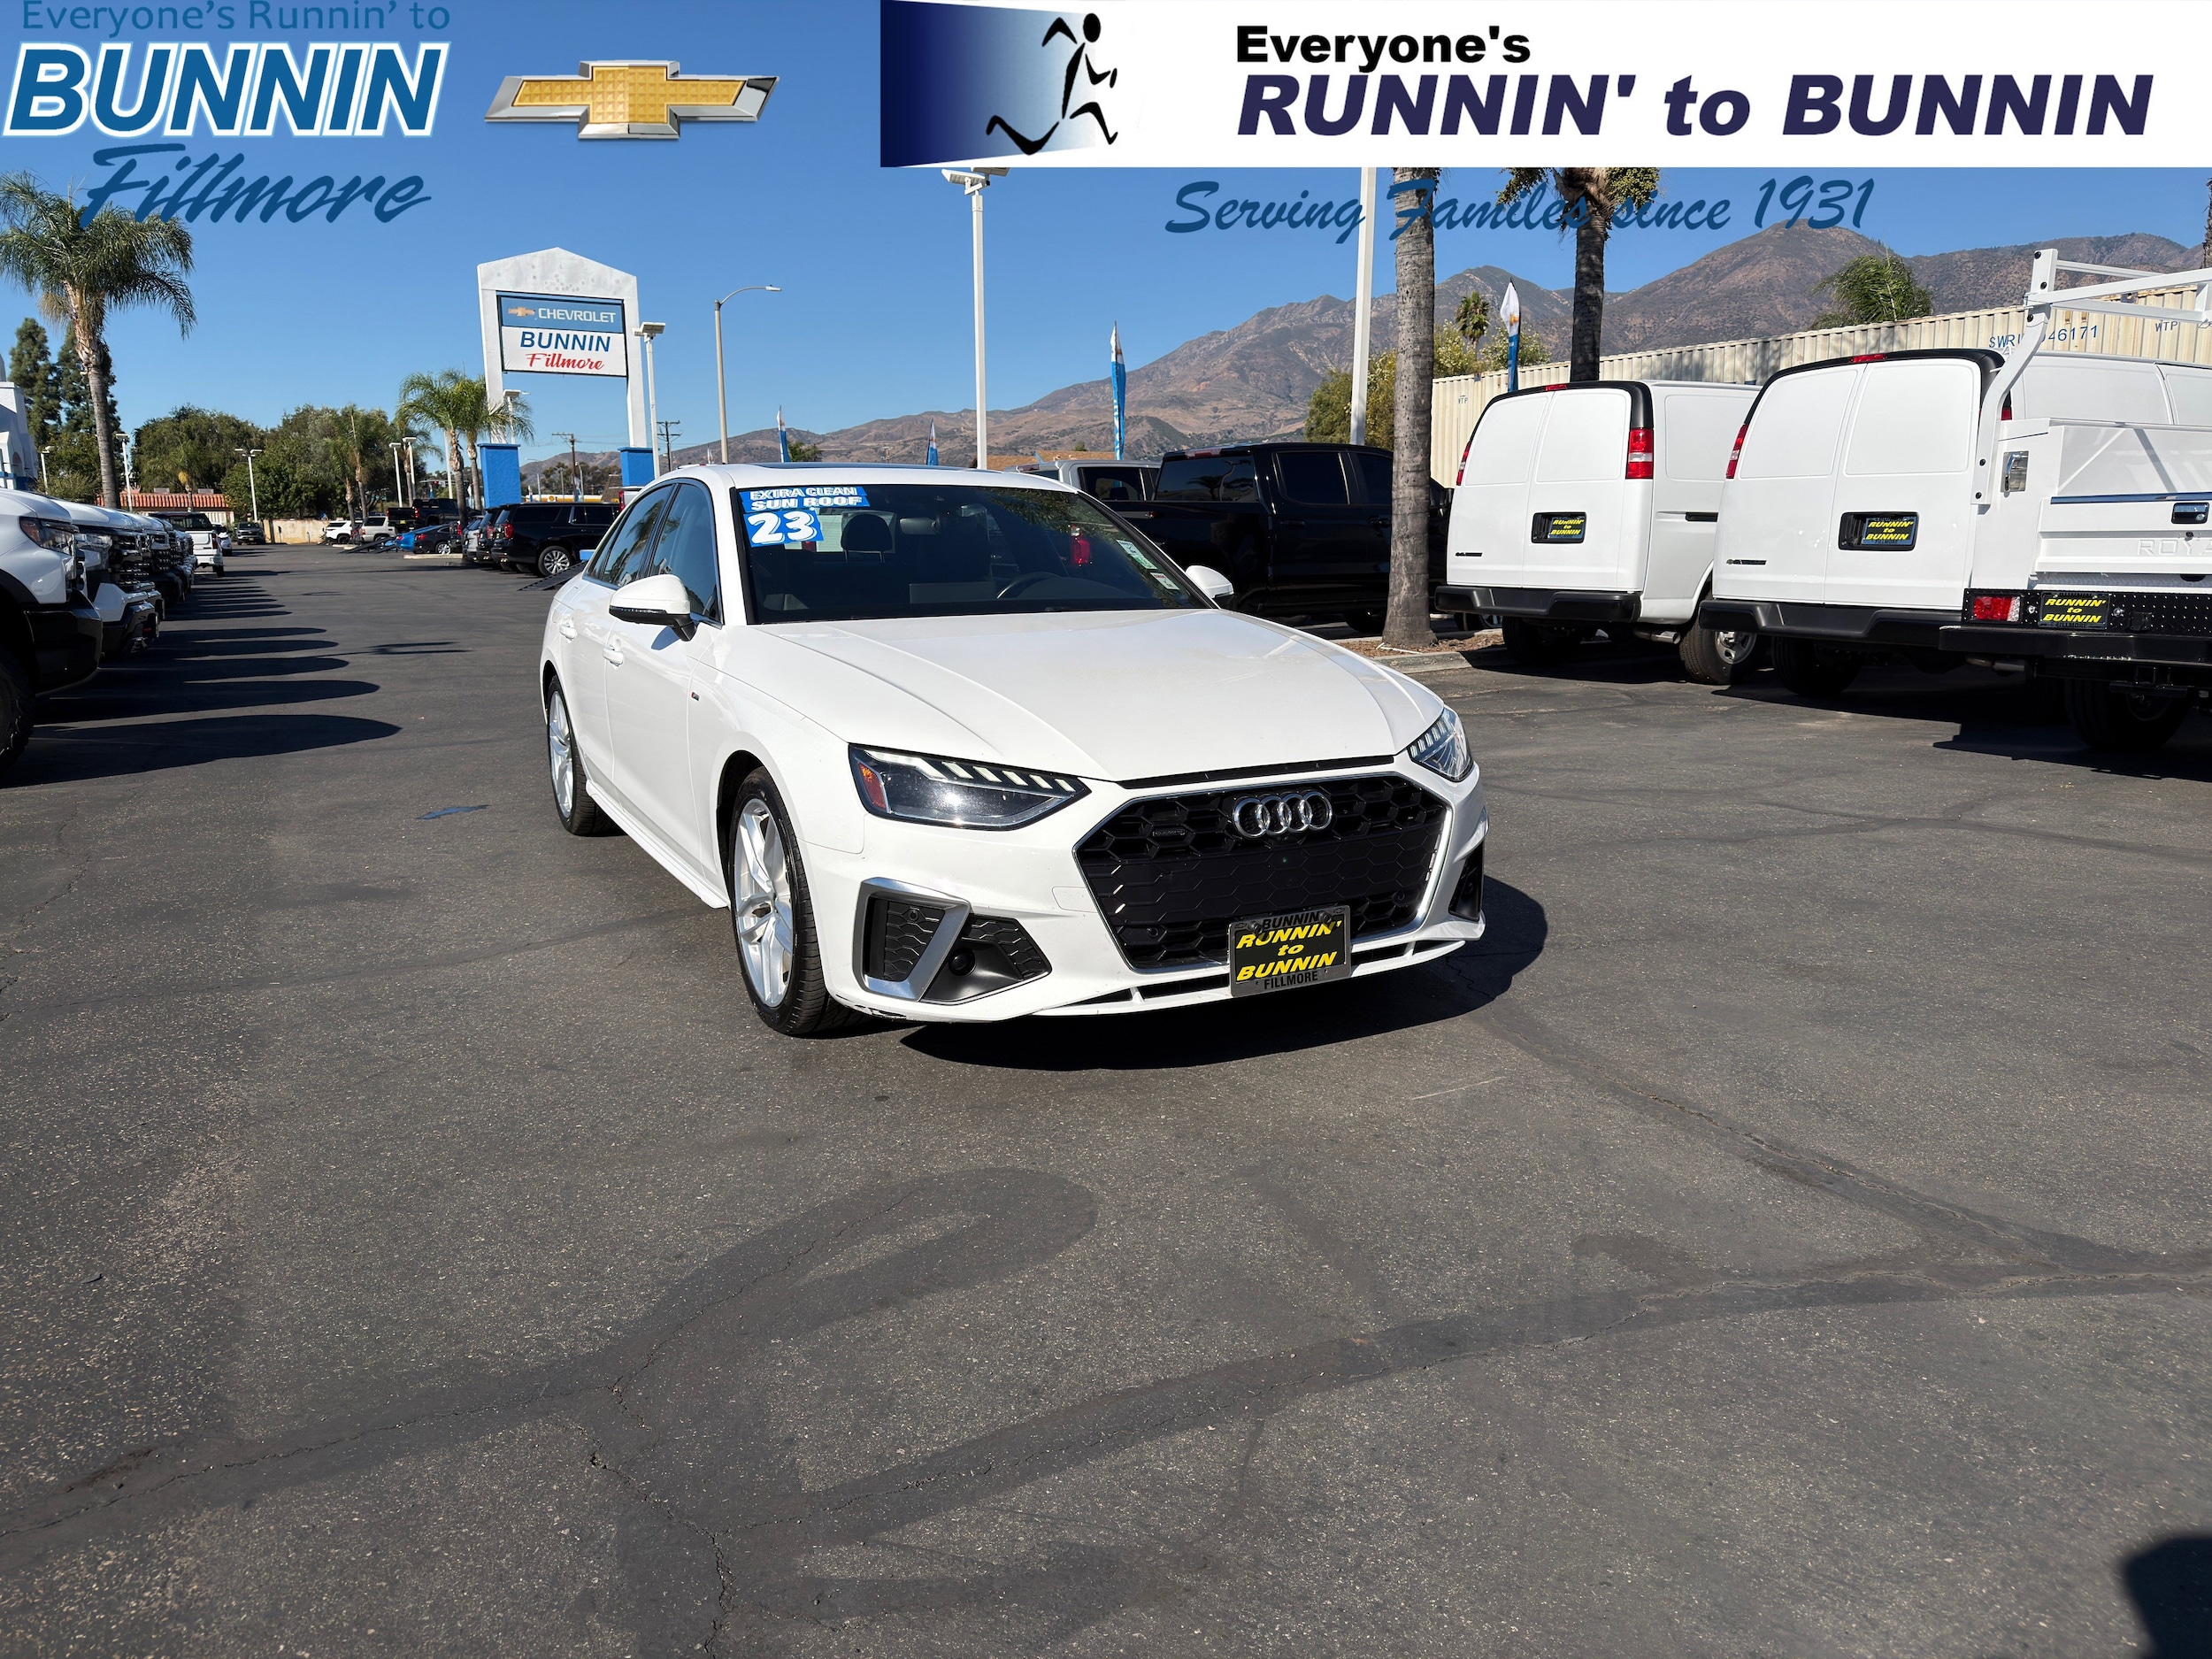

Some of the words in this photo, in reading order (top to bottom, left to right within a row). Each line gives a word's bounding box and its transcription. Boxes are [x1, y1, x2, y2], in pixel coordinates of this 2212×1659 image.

[538, 308, 616, 323] CHEVROLET
[2154, 320, 2178, 332] WTP
[519, 331, 611, 352] BUNNIN
[526, 352, 604, 371] Fillmore
[749, 488, 805, 501] EXTRA
[805, 486, 858, 496] CLEAN
[751, 498, 798, 511] SUN
[803, 495, 863, 507] ROOF
[747, 511, 818, 545] 23
[2044, 598, 2107, 607] RUNNIN'
[2042, 613, 2102, 623] BUNNIN
[1262, 910, 1321, 930] BUNNIN
[1236, 920, 1342, 949] RUNNIN'
[1277, 944, 1305, 956] to
[1236, 951, 1338, 982] BUNNIN
[1263, 971, 1318, 990] FILLMORE
